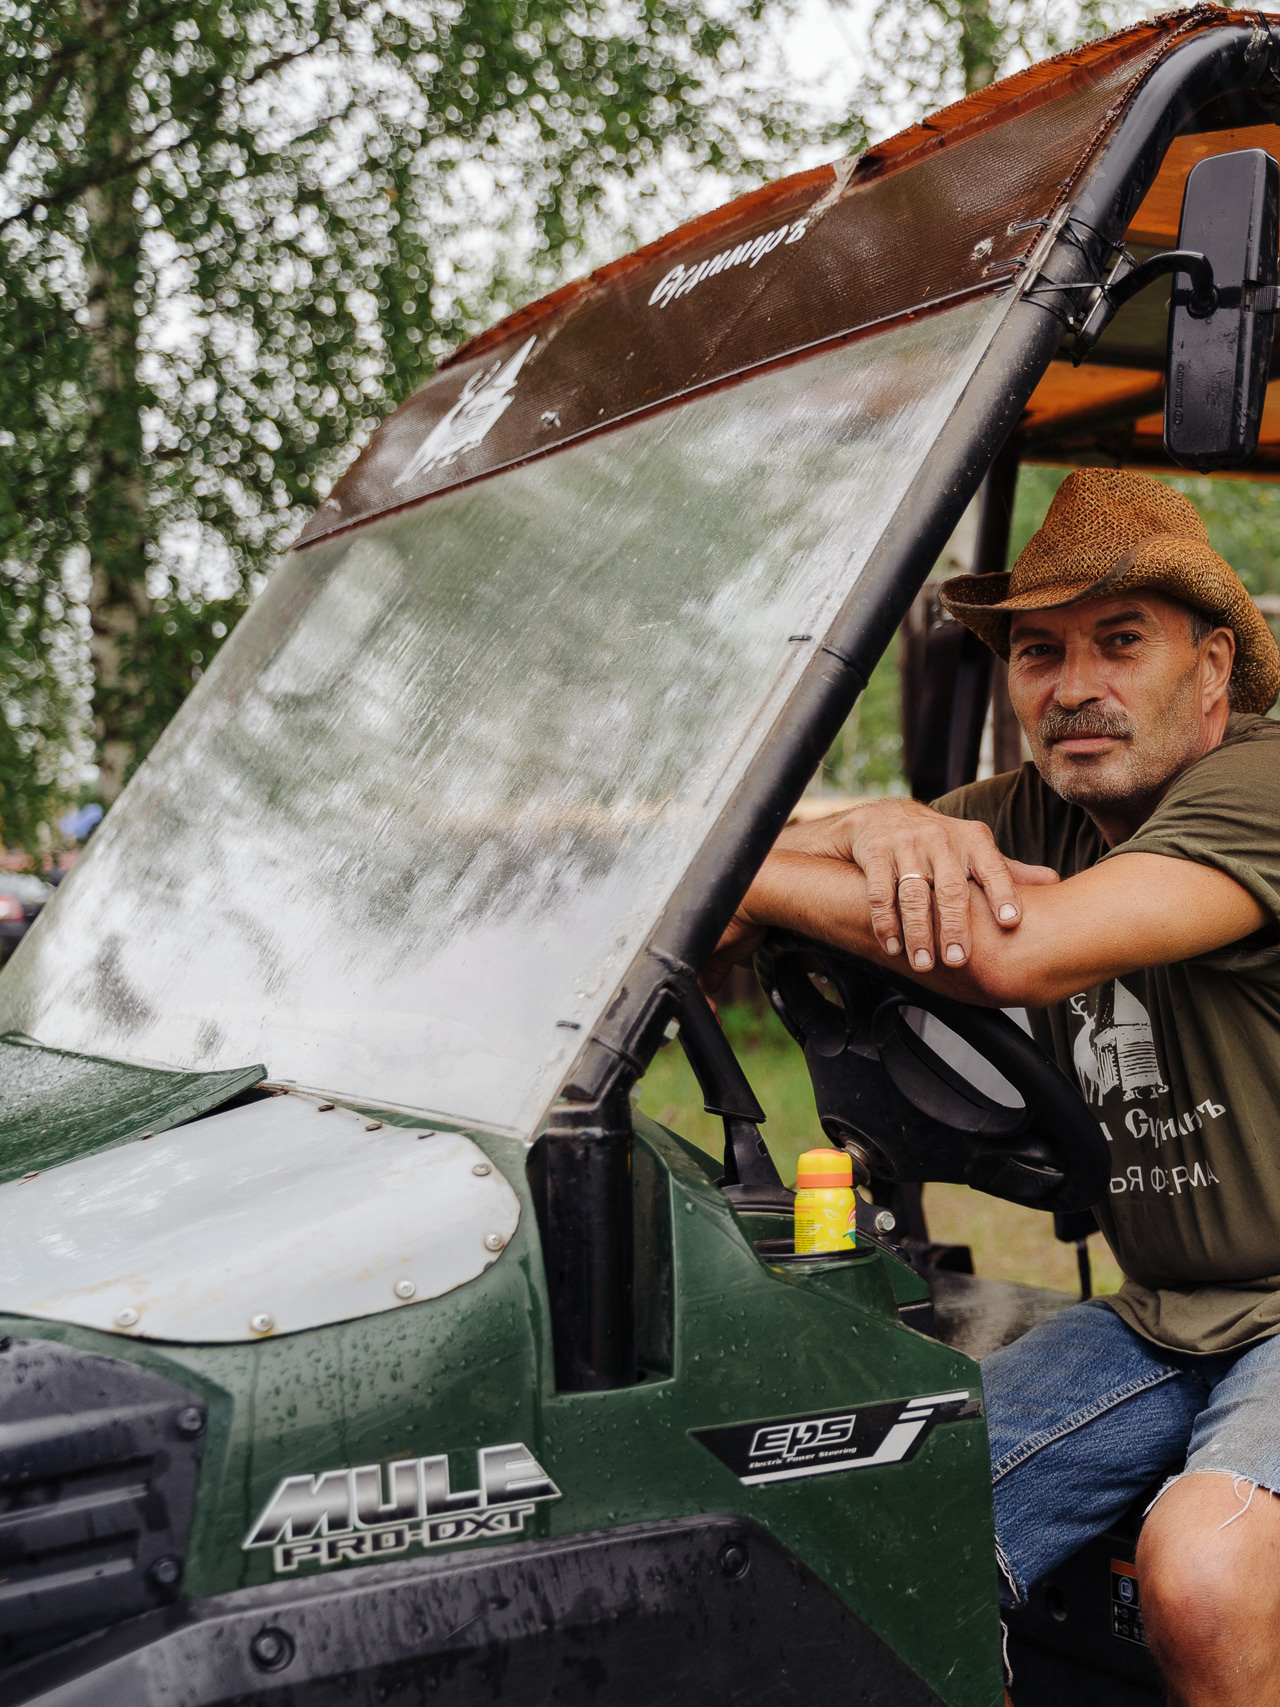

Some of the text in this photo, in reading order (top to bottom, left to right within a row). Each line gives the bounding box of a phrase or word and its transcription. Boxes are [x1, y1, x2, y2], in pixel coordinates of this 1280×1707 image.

[749, 1415, 856, 1457] EPS
[749, 1446, 858, 1469] Electric Power Steering
[242, 1442, 562, 1549] MULE
[274, 1503, 535, 1573] PRO-DXT
